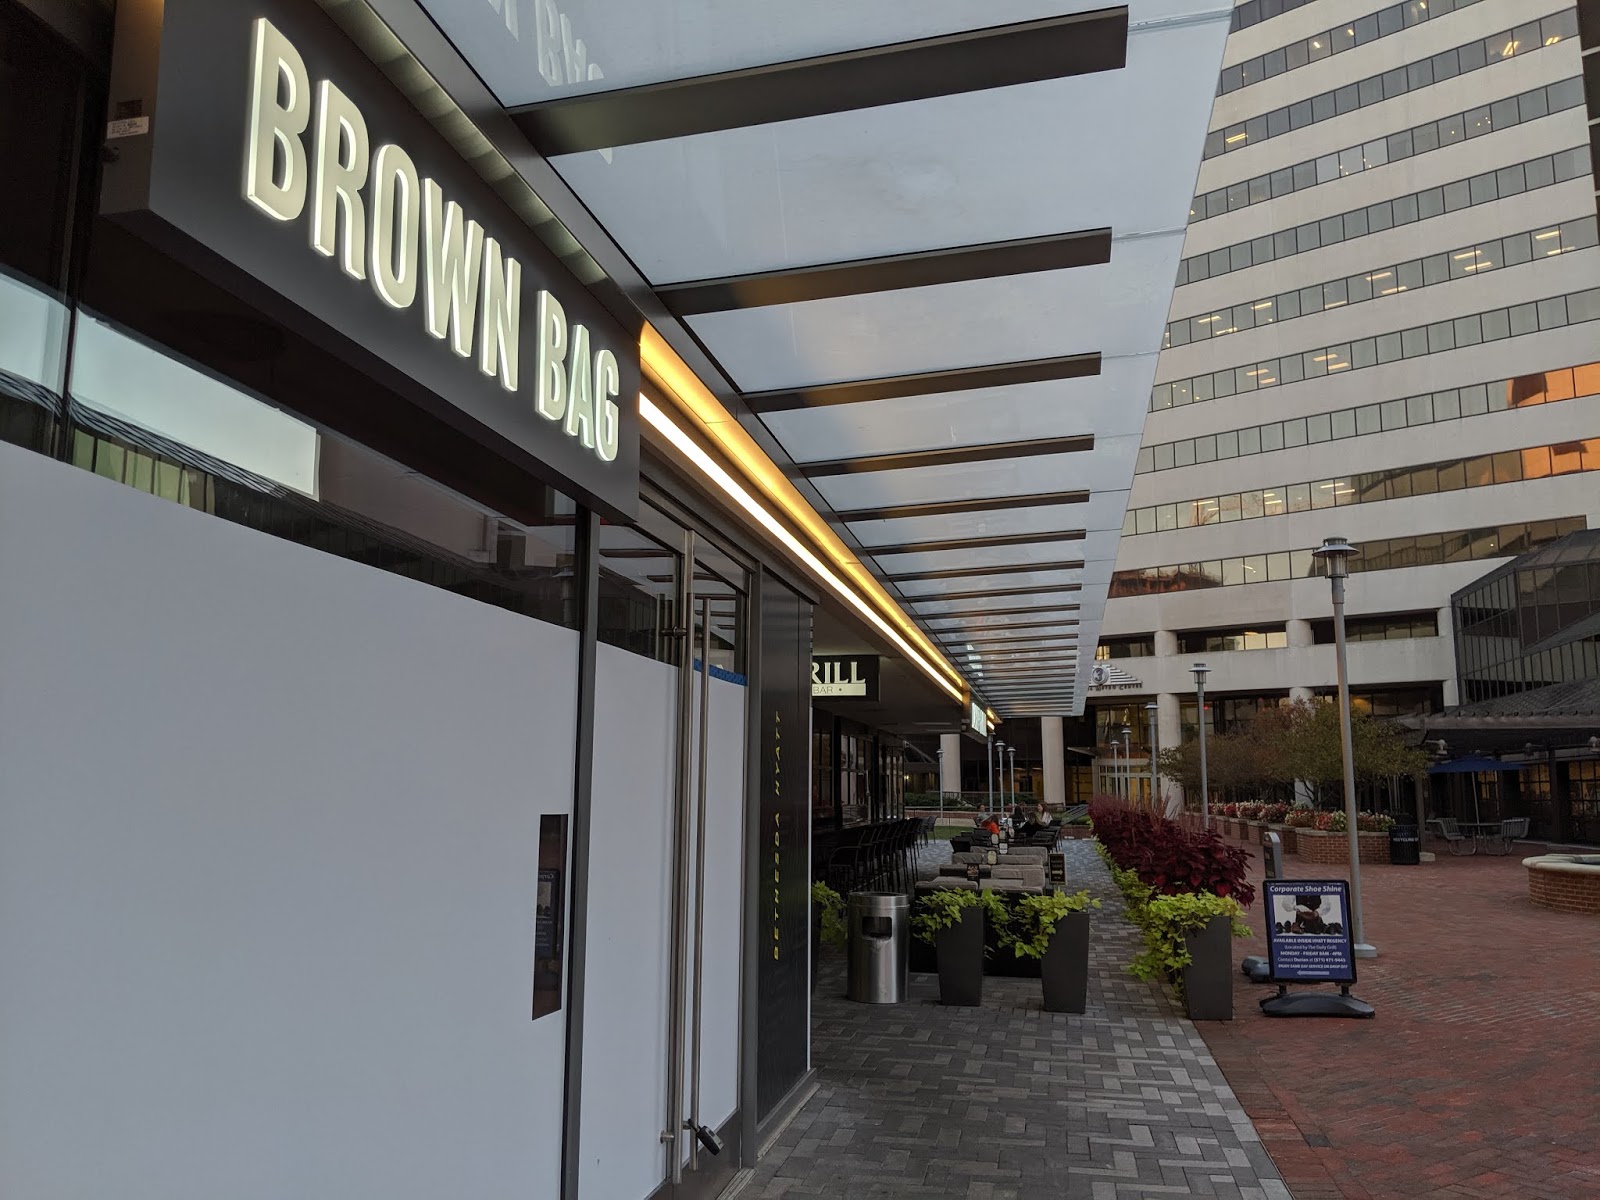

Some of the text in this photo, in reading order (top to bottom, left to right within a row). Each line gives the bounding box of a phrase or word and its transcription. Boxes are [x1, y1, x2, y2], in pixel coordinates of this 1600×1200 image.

[243, 16, 621, 463] BROWN BAG
[813, 686, 834, 695] BAR
[1269, 885, 1304, 894] Corporate
[1322, 885, 1342, 893] Shine
